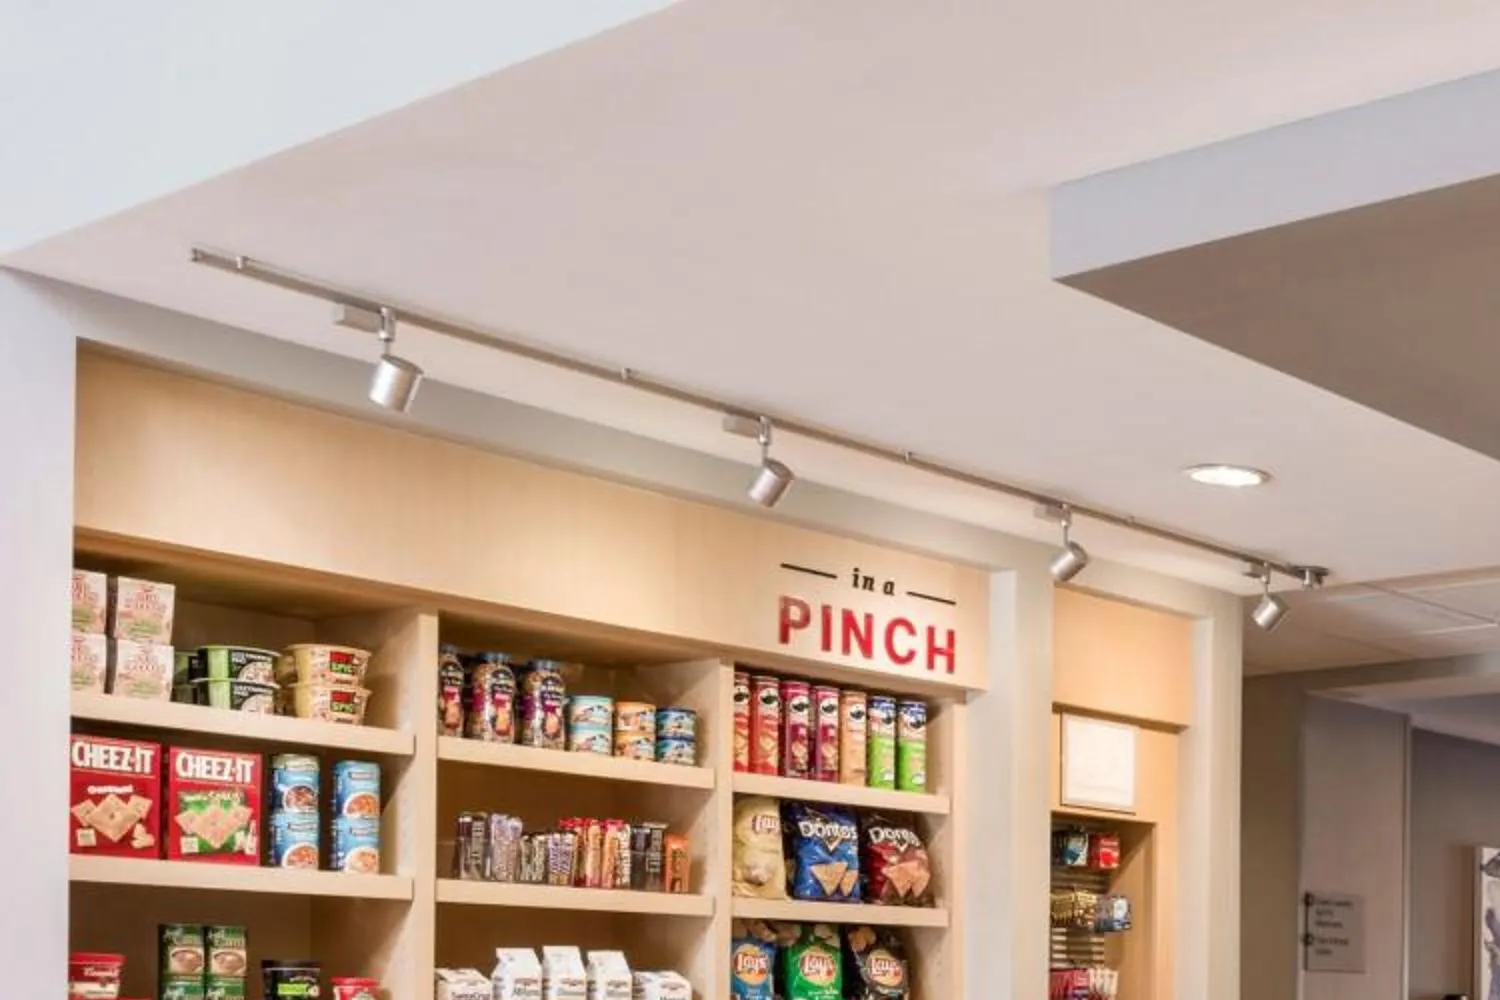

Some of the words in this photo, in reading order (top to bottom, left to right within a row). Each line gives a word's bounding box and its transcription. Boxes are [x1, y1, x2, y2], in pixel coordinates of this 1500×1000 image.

[851, 567, 875, 592] in
[883, 581, 896, 596] a
[778, 595, 956, 674] PINCH
[72, 740, 155, 775] CHEEZ-IT
[175, 751, 255, 784] CHEEZ-IT
[798, 820, 858, 842] Doritos
